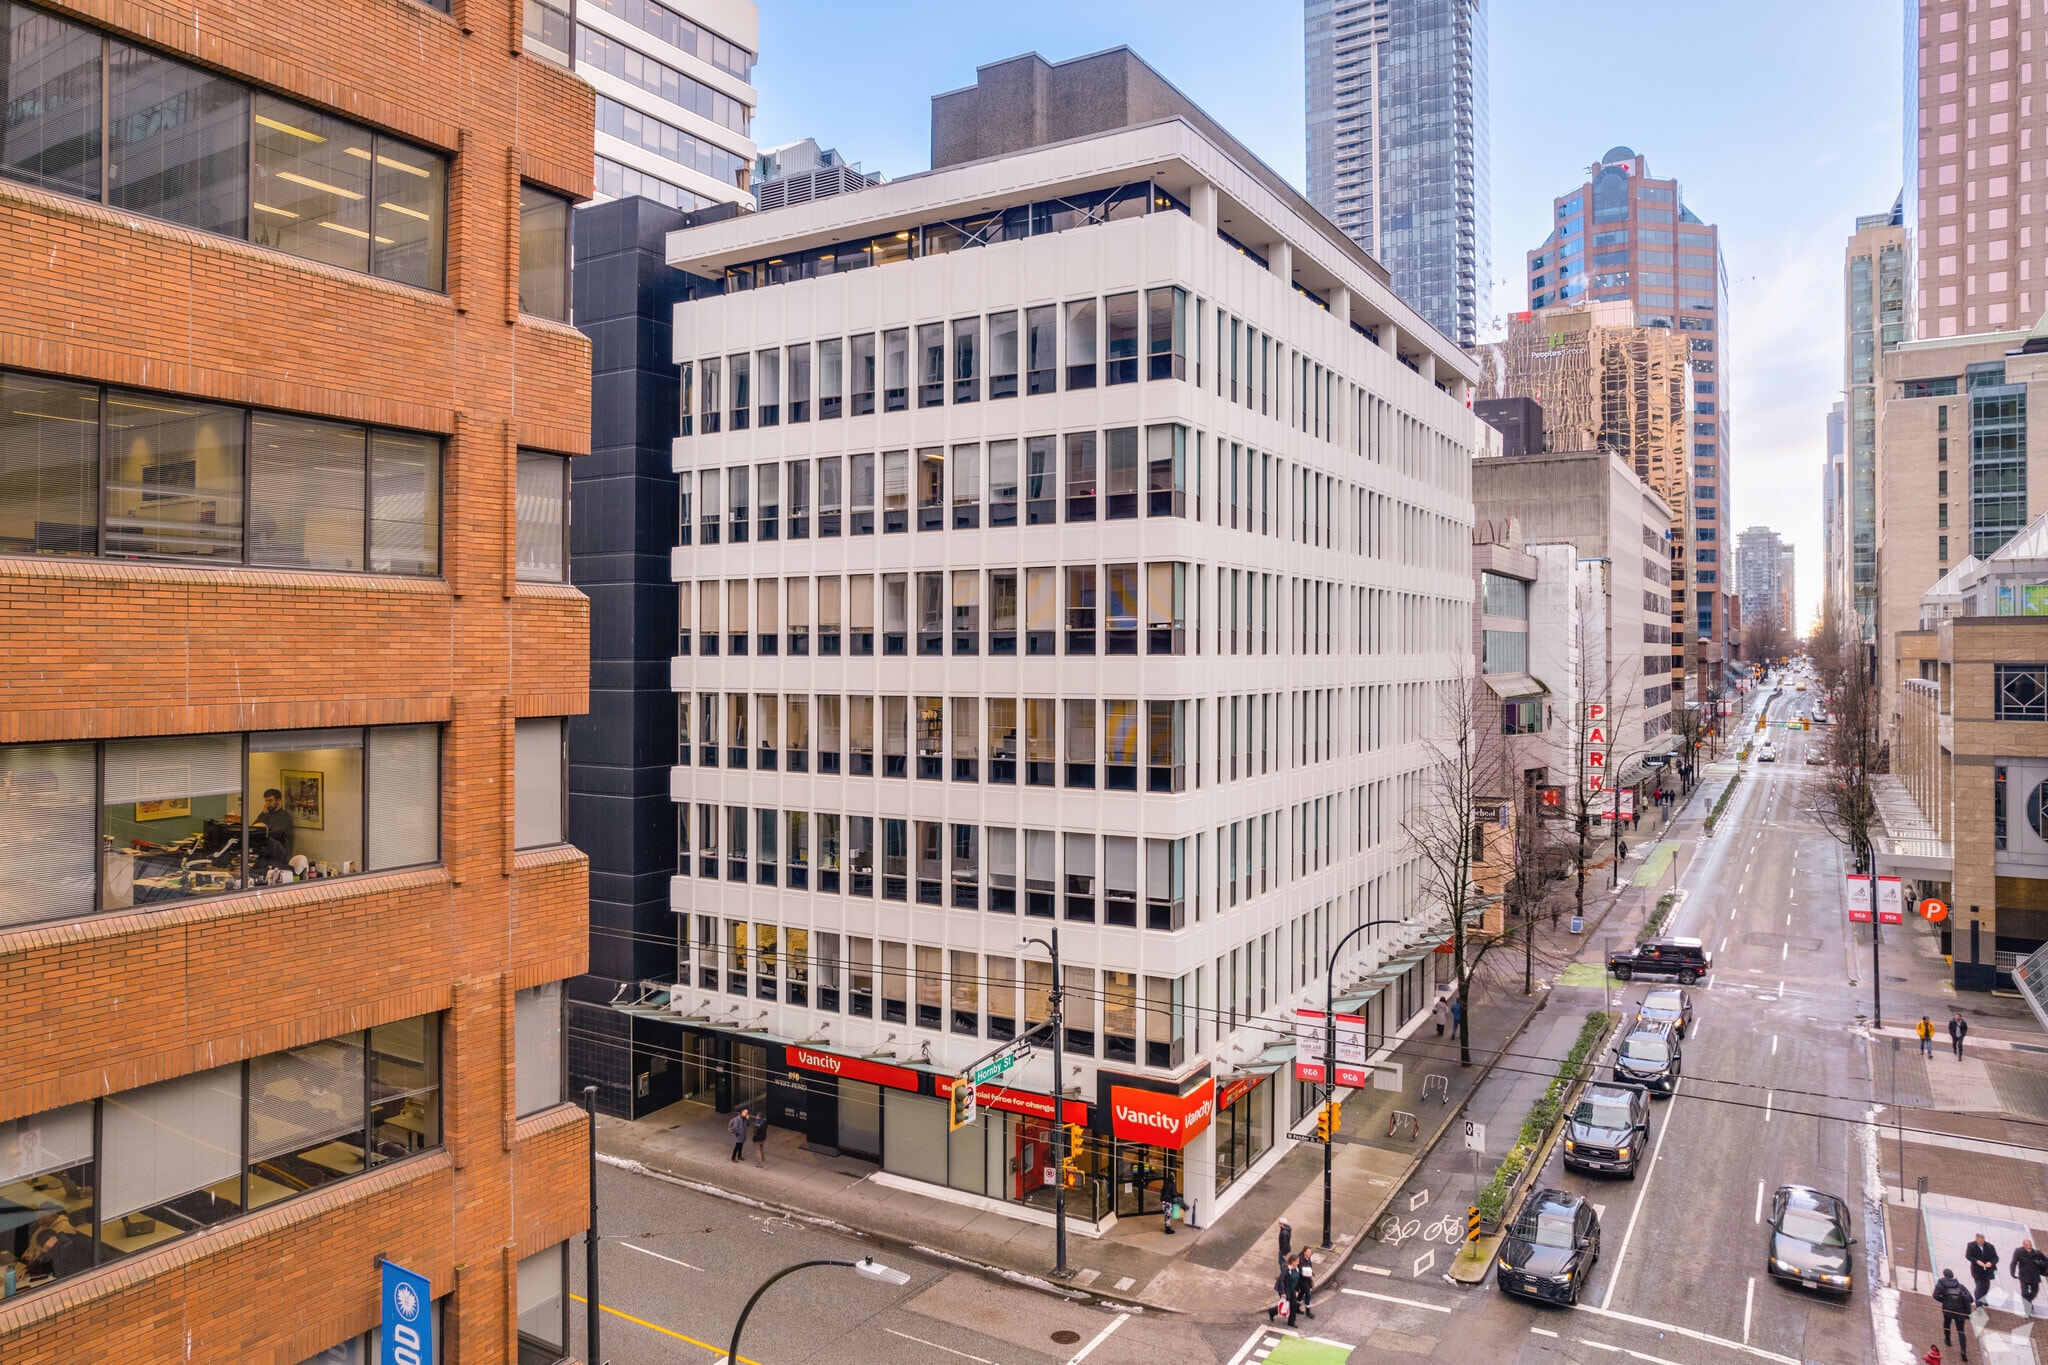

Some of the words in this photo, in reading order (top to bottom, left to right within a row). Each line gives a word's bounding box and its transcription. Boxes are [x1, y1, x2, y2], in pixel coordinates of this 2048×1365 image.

[1531, 349, 1562, 359] Peoples
[1564, 347, 1586, 356] Group
[1590, 704, 1604, 790] PARK
[1926, 902, 1942, 919] P
[798, 1050, 841, 1073] Vancity
[977, 1063, 1002, 1082] Hornby
[1004, 1057, 1011, 1068] St
[1013, 1097, 1025, 1106] for
[1184, 1097, 1214, 1129] Vancity
[1115, 1104, 1180, 1134] Vancity
